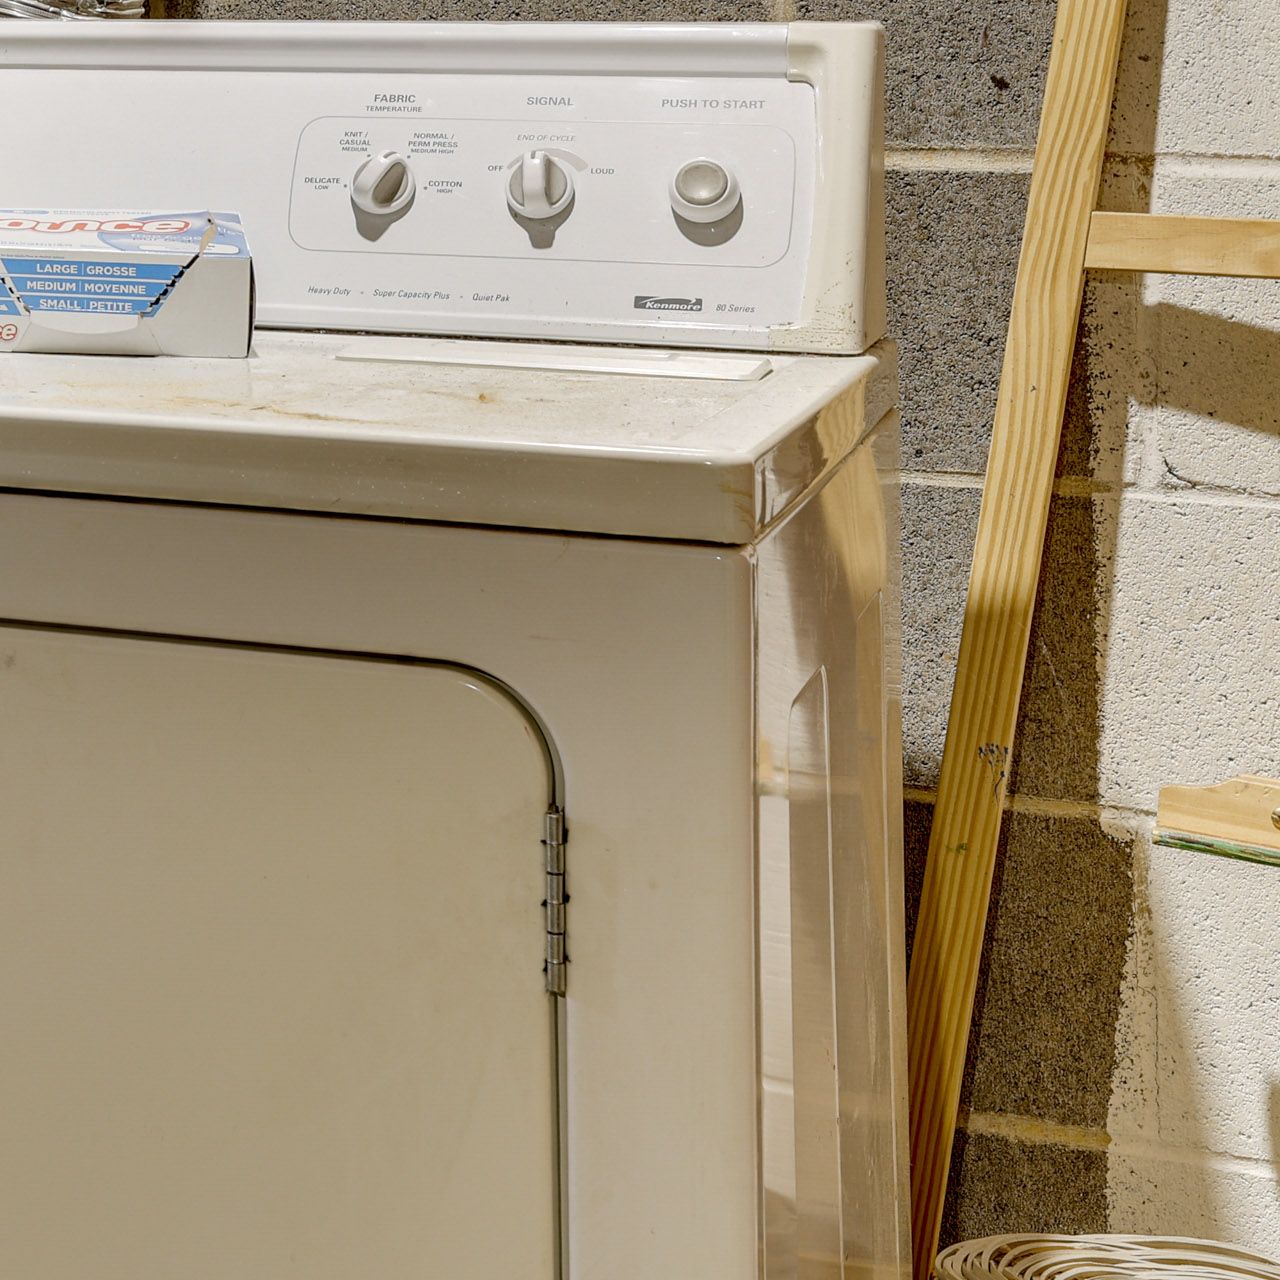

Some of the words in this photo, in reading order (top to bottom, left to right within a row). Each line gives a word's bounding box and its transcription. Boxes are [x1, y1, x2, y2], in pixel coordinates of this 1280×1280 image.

[374, 94, 416, 103] FABRIC
[526, 96, 574, 106] SIGNAL
[662, 99, 697, 108] PUSH
[702, 100, 719, 108] TO
[723, 100, 765, 109] START
[36, 264, 78, 274] LARGE
[86, 266, 136, 276] GROSSE
[27, 281, 76, 291] MEDIUM
[84, 283, 146, 294] MOYENNE
[308, 286, 332, 295] Heavy
[333, 287, 351, 296] Duty
[373, 289, 396, 298] Super
[398, 290, 431, 300] Capacity
[433, 292, 450, 300] Plus
[472, 293, 494, 302] Quiet
[495, 294, 510, 302] Pak
[40, 299, 81, 309] SMALL
[90, 301, 133, 312] PETITE
[645, 302, 701, 311] Kenmore
[728, 304, 755, 312] Series
